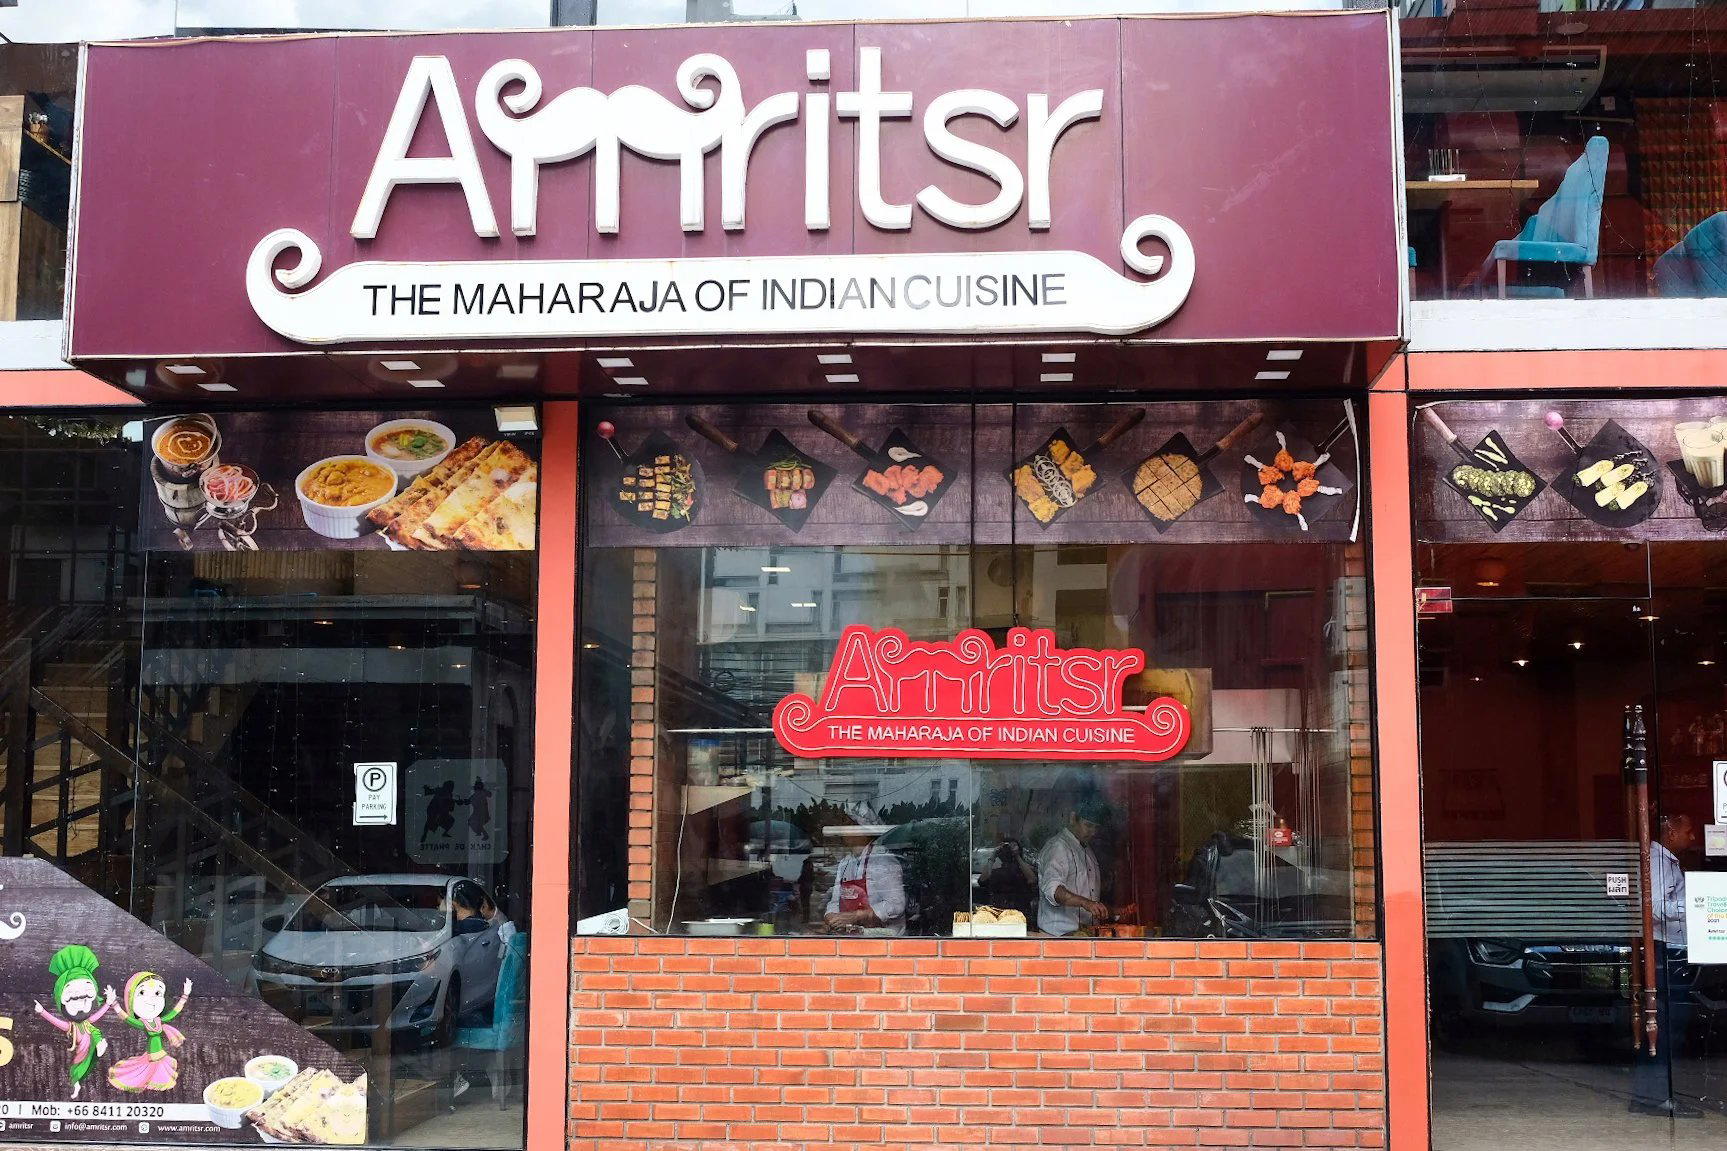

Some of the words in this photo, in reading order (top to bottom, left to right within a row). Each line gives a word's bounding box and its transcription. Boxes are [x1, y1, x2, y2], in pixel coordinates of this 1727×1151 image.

[350, 46, 1103, 240] Amritsr
[363, 284, 441, 316] THE
[453, 280, 687, 315] MAHARAJA
[695, 278, 751, 313] OF
[762, 276, 896, 311] INDIAN
[903, 273, 1068, 310] CUISINE
[825, 631, 1139, 716] Amritsr
[828, 725, 862, 741] THE
[867, 725, 964, 741] MAHARAJA
[968, 726, 990, 742] OF
[998, 726, 1058, 743] INDIAN
[1063, 727, 1135, 744] CUISINE
[370, 772, 381, 787] P
[1608, 876, 1627, 884] PUSH
[32, 1104, 60, 1116] Mob:
[67, 1105, 89, 1116] +66
[92, 1105, 122, 1117] 8411
[126, 1106, 165, 1118] 20320
[8, 1121, 34, 1130] amritsr
[64, 1122, 128, 1132] info@amritsr.com
[157, 1123, 221, 1132] www.amritsr.com
